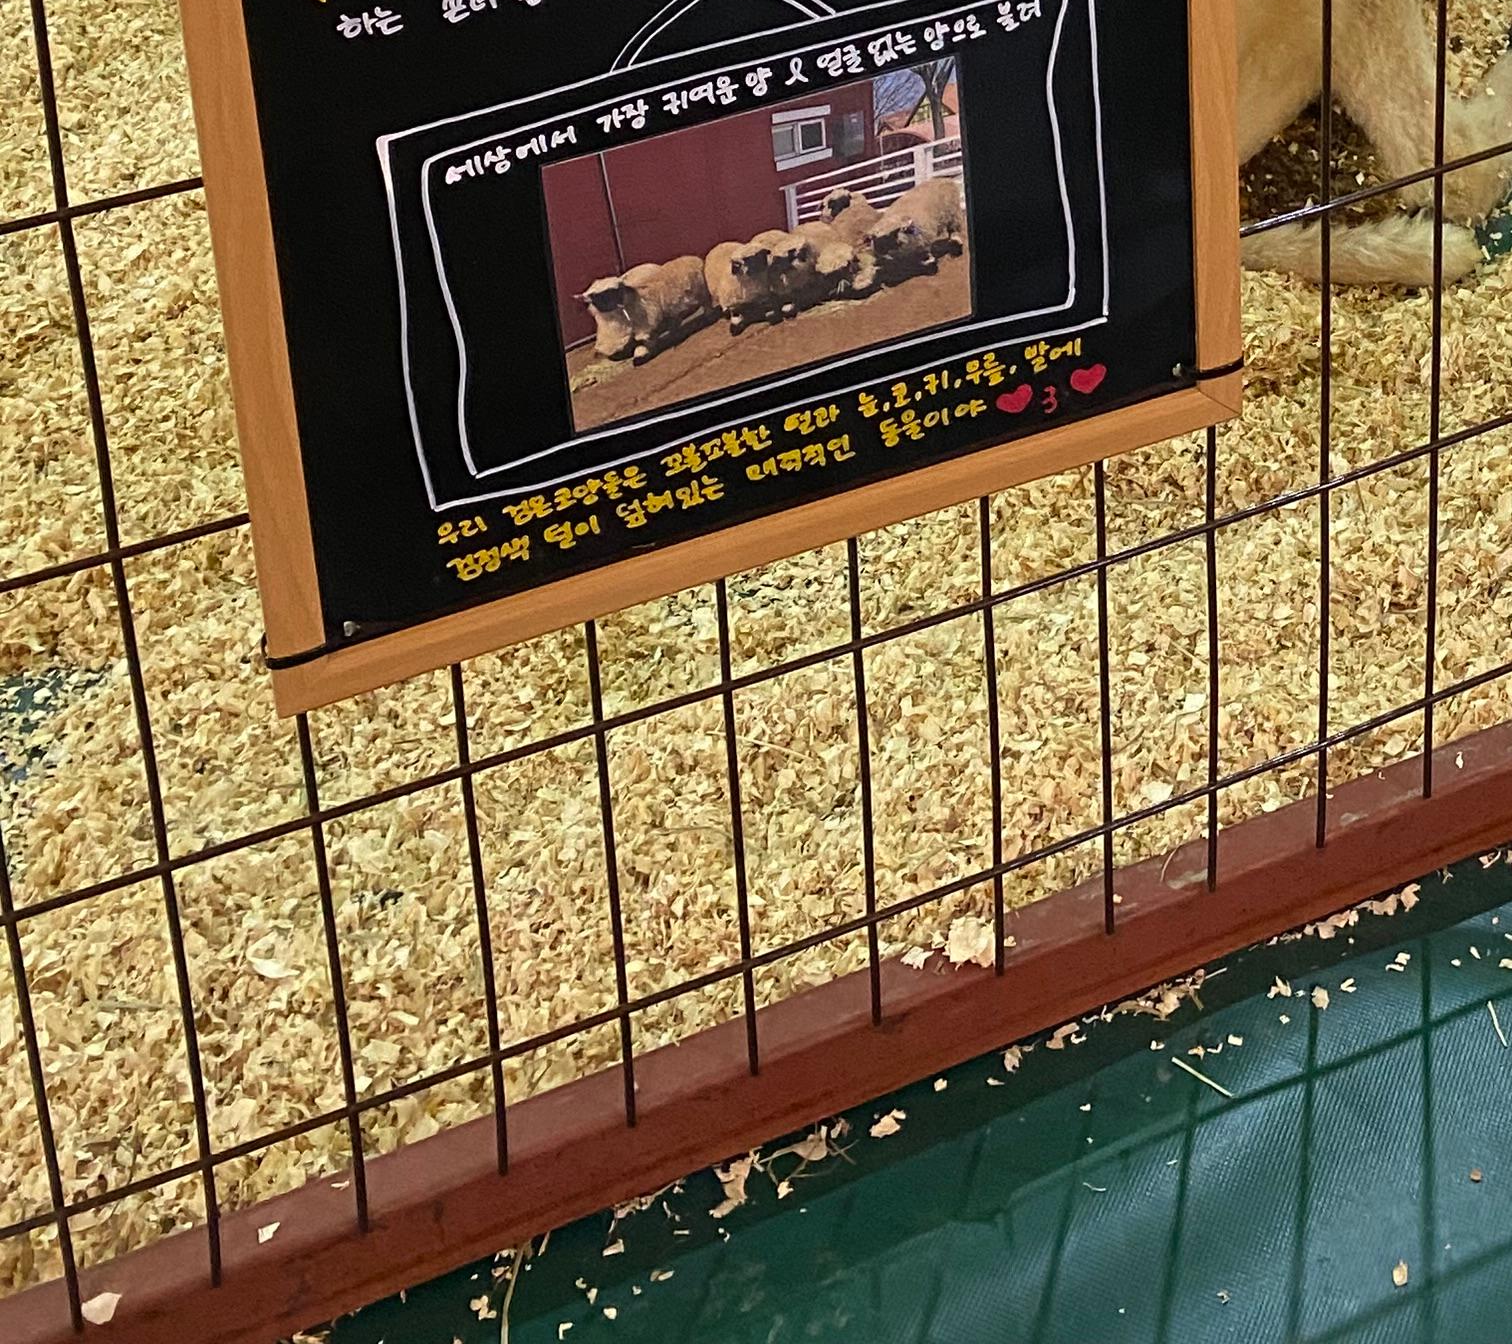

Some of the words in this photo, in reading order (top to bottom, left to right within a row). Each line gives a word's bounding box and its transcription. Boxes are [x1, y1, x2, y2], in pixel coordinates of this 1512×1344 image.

[336, 7, 404, 39] 하는
[445, 125, 577, 184] 세상에서
[596, 98, 649, 133] 가장
[662, 76, 739, 114] 귀여운
[745, 66, 773, 96] 양
[924, 14, 987, 51] 양으로
[437, 515, 488, 544] 우리
[1024, 337, 1081, 374] 발에
[543, 515, 600, 549] 털이
[879, 398, 987, 447] 동물이야
